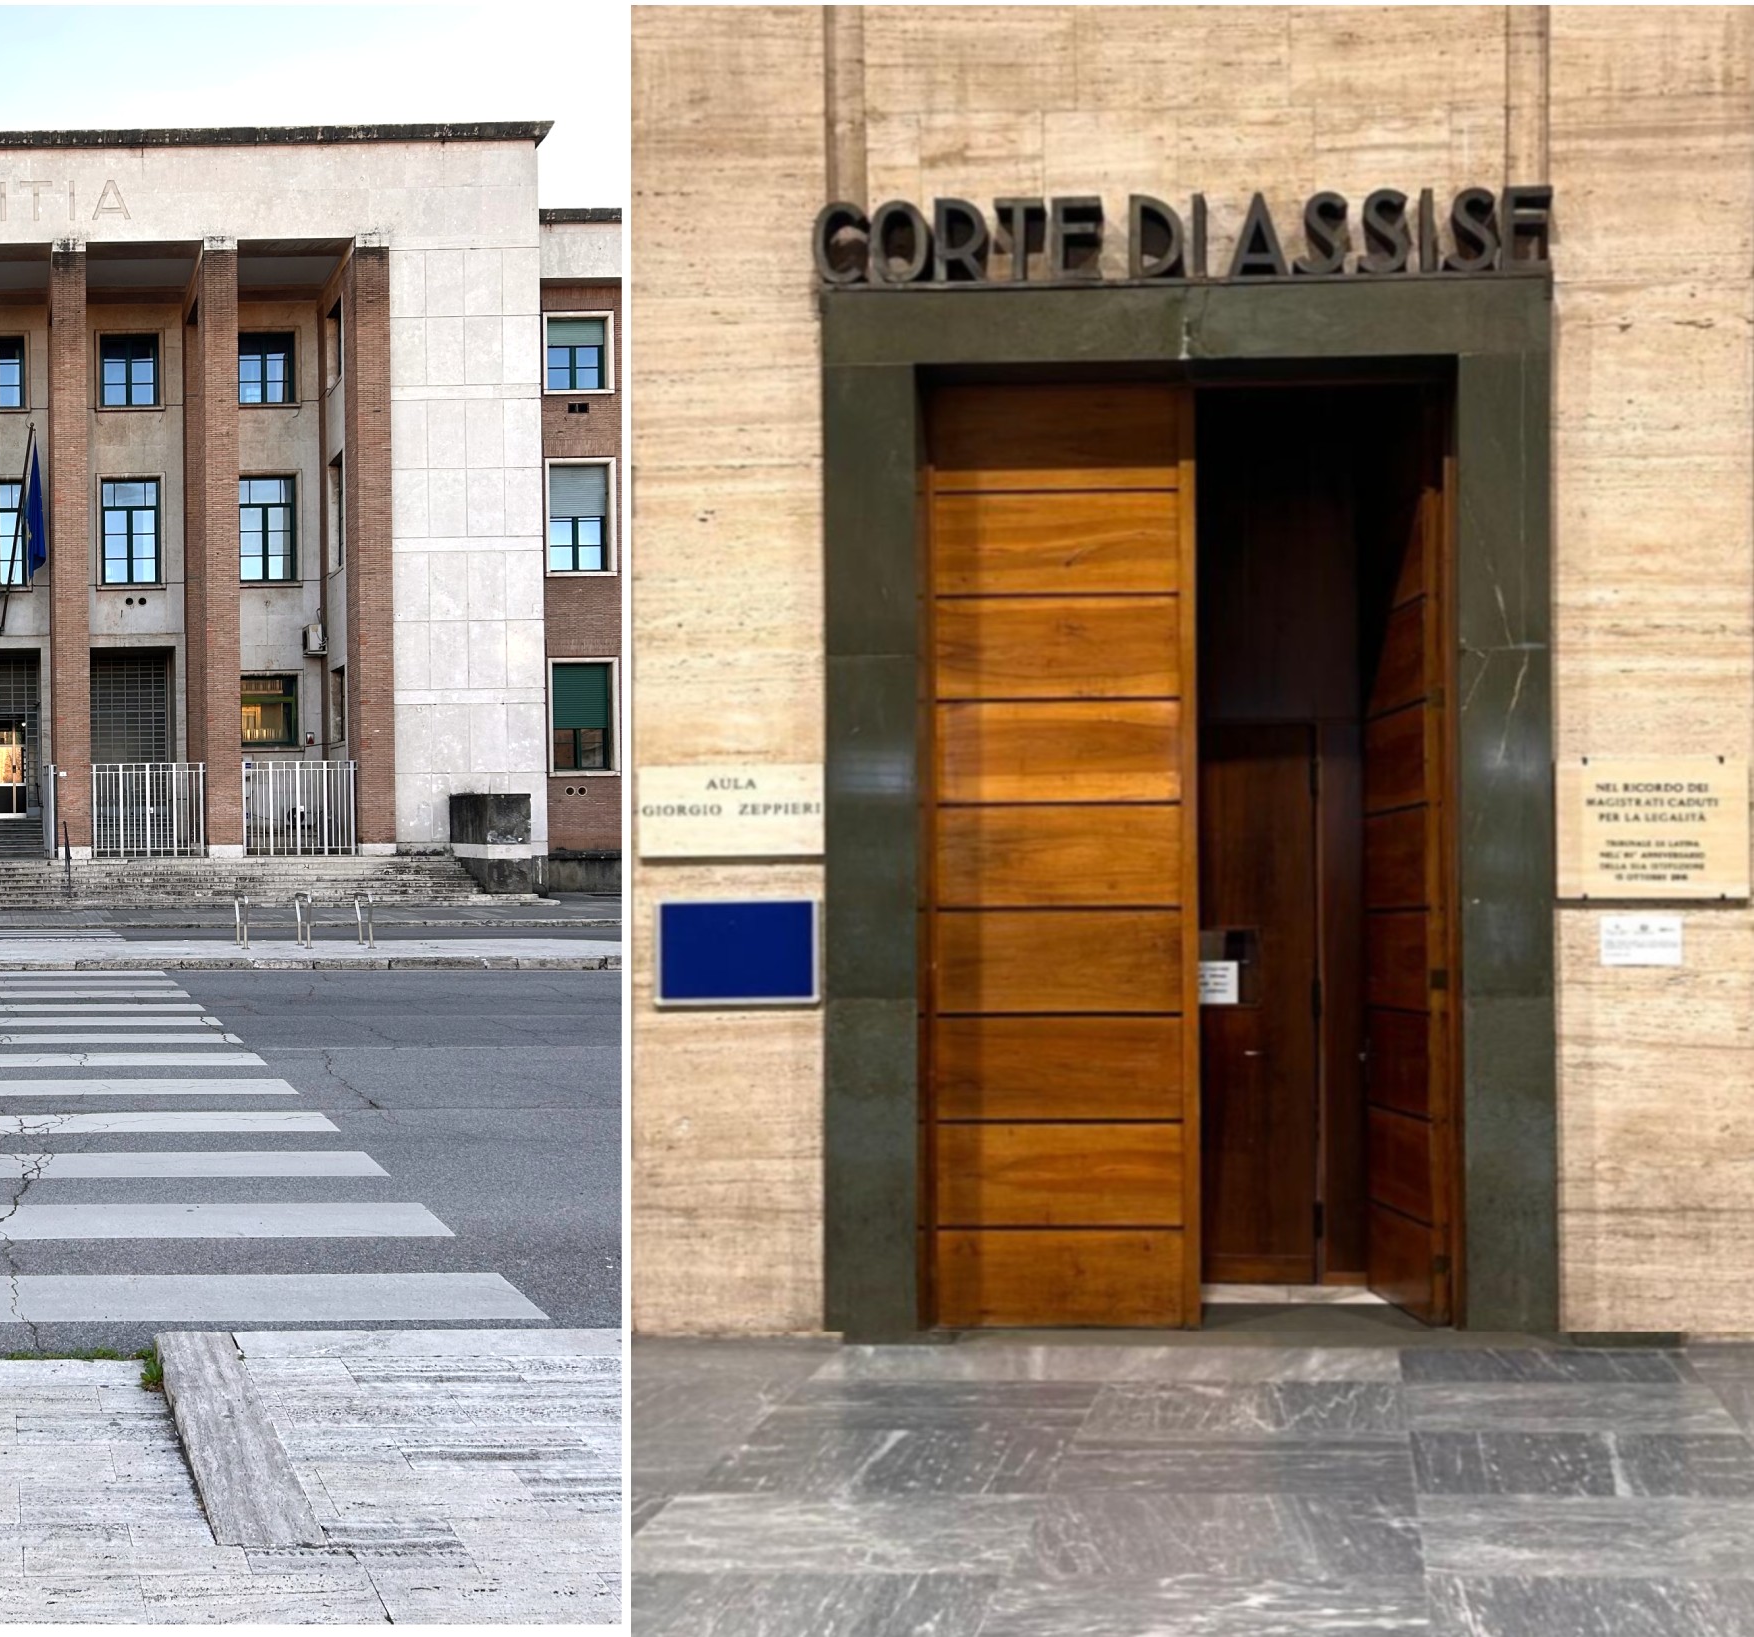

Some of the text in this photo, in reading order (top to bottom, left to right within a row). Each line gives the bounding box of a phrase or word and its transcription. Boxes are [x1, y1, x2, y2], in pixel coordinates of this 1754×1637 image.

[811, 184, 1554, 285] CORTE DI ASSISE
[705, 778, 758, 791] AULA
[1595, 783, 1709, 793] NEL RICORDO DEI
[1586, 798, 1719, 807] MAGISTRATI CADUTI
[642, 802, 822, 817] GIORGIO ZEPPIERI
[1598, 813, 1620, 823] PER
[1624, 813, 1641, 823] LA
